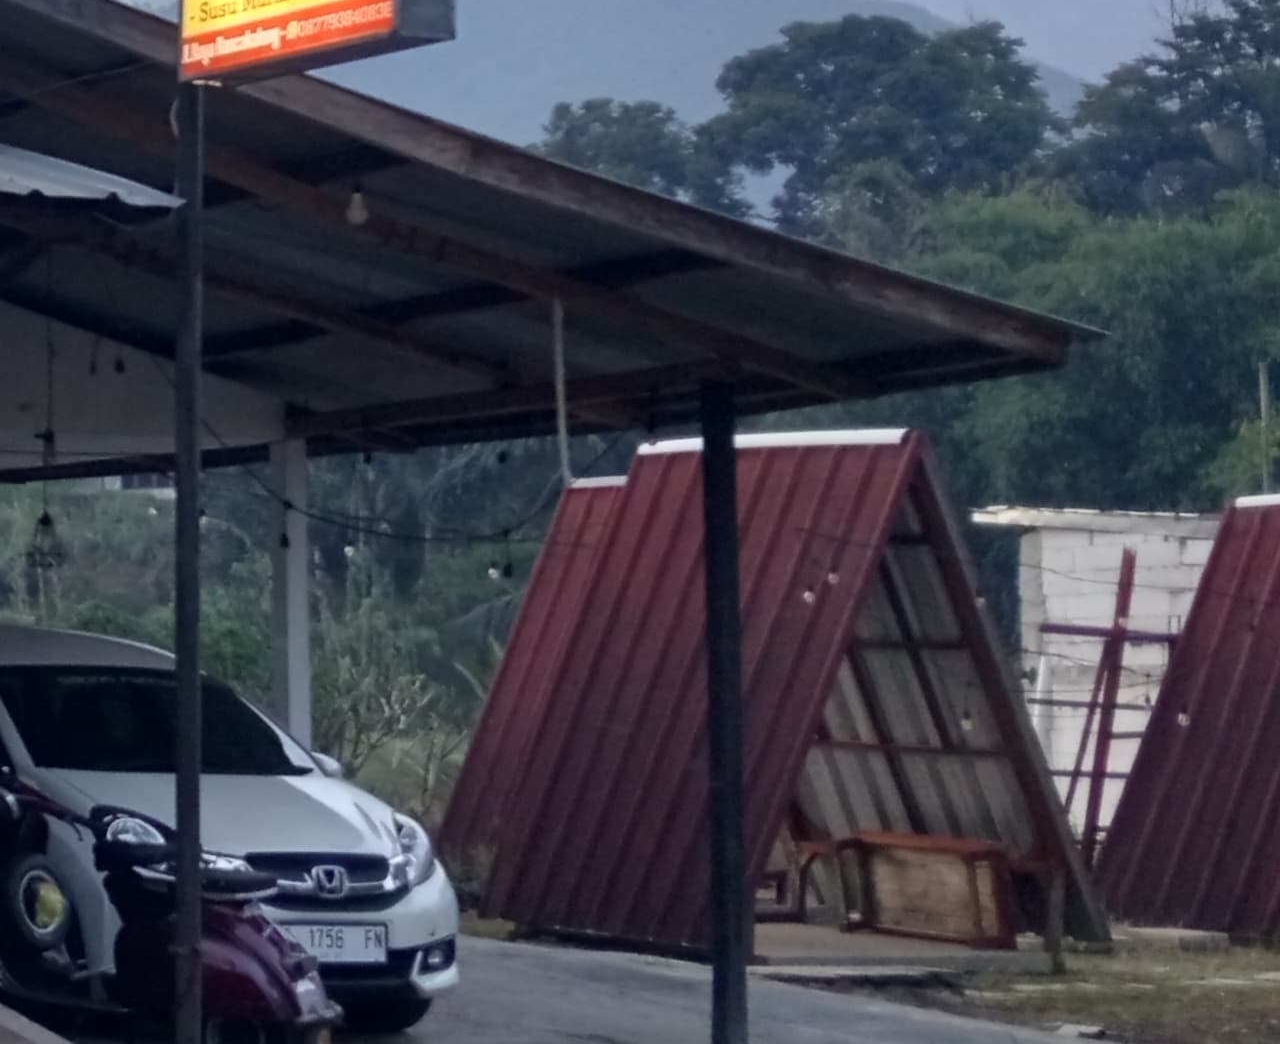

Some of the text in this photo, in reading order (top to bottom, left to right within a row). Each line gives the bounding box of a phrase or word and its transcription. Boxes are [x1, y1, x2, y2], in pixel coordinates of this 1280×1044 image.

[199, 1, 237, 22] Susu
[309, 927, 344, 949] 1756
[364, 928, 383, 949] FN
